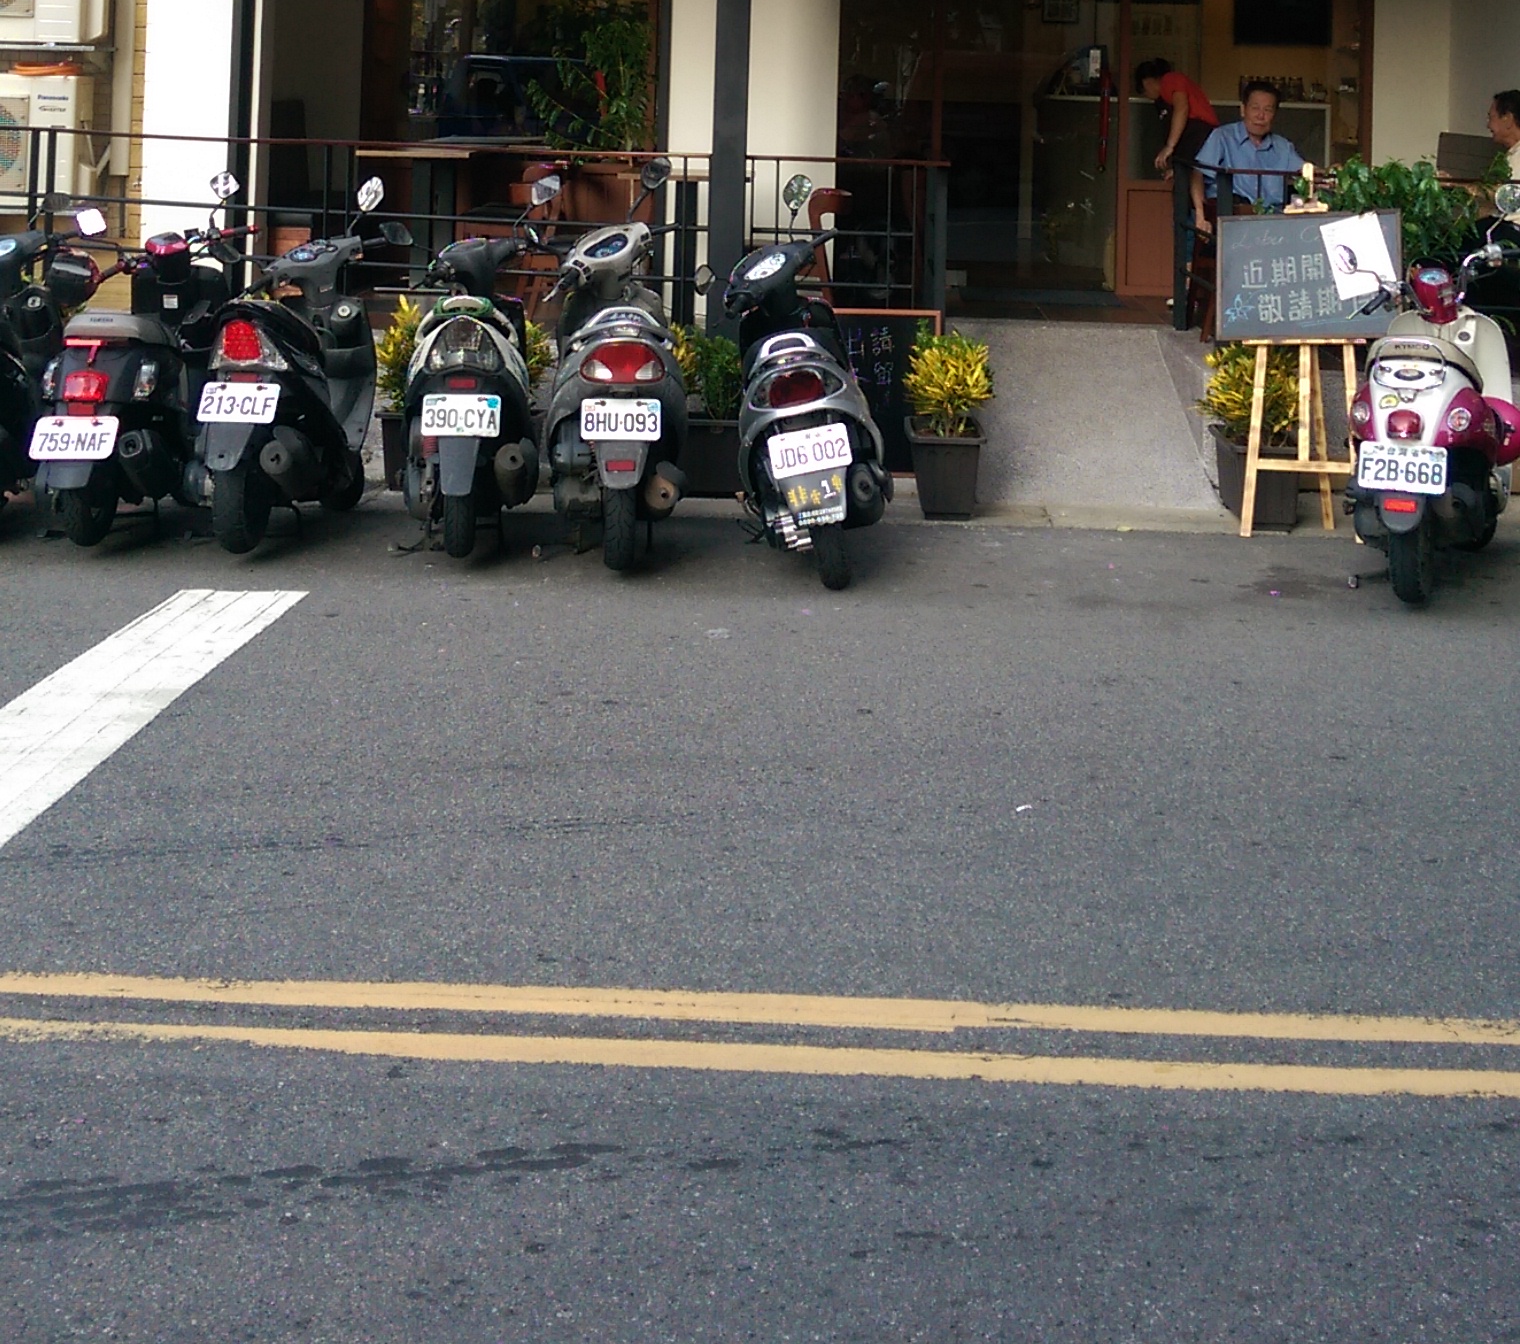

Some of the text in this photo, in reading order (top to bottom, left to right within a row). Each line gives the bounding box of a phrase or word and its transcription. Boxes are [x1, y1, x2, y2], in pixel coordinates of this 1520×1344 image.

[1241, 253, 1334, 289] 近期開
[1394, 343, 1430, 351] KYMCO
